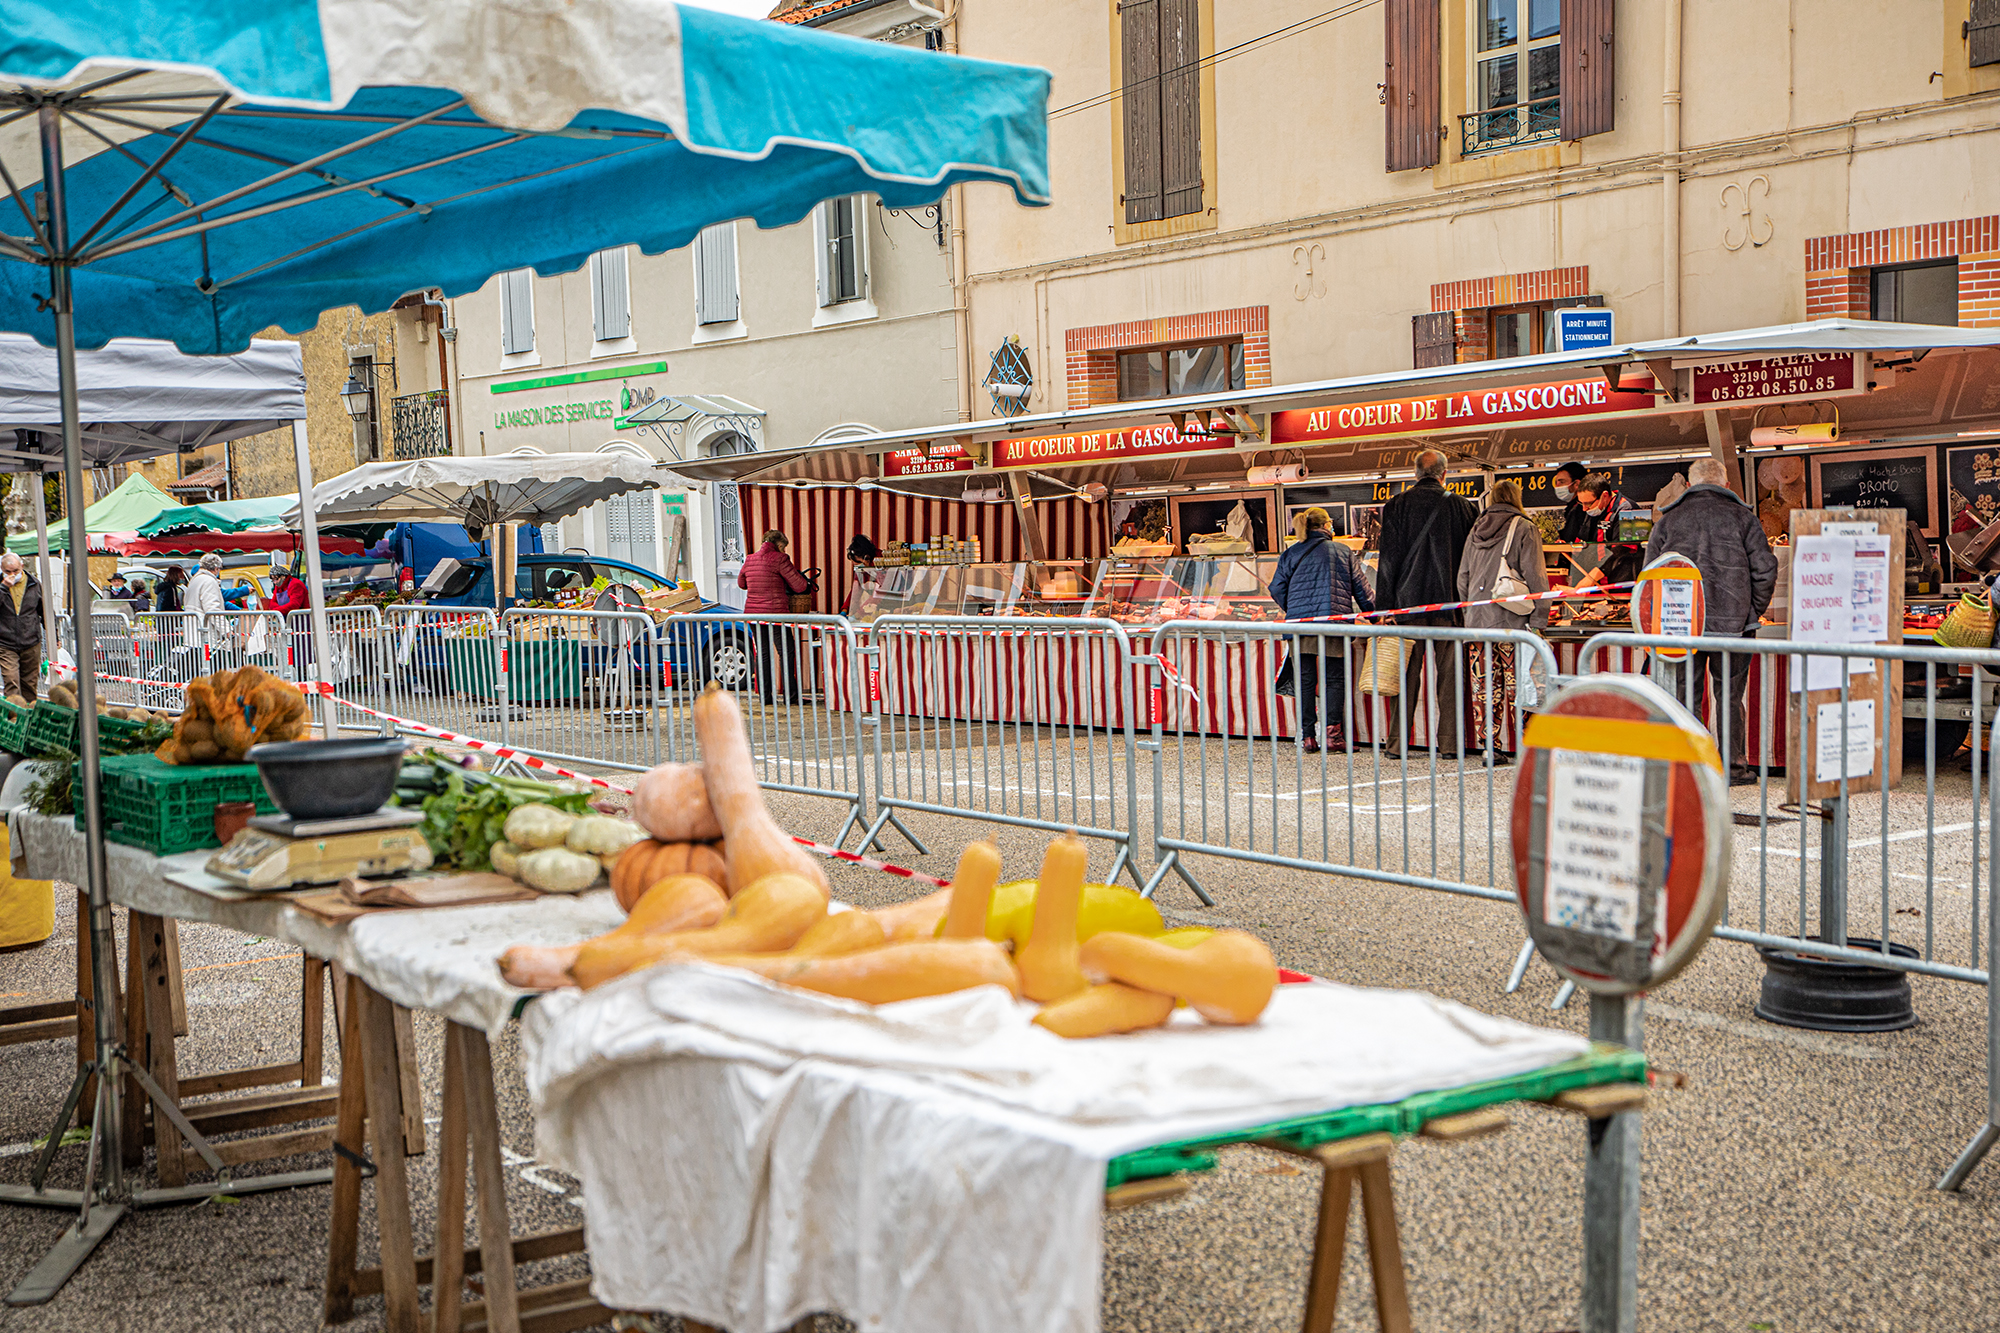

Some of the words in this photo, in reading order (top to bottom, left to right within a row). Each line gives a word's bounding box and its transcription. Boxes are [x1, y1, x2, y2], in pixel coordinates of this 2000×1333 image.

[1566, 319, 1584, 328] ARRÊT
[1586, 319, 1607, 328] MINUTE
[1565, 333, 1609, 341] STATIONNEMENT
[1732, 369, 1768, 384] 32190
[1774, 364, 1813, 380] DEMU
[1711, 376, 1836, 401] 05.62.08.50.85
[1306, 410, 1331, 432] AU
[1338, 403, 1403, 429] COEUR
[1411, 399, 1438, 422] DE
[1445, 395, 1474, 419] LA
[1482, 380, 1607, 415] GASCOGNE
[494, 412, 507, 429] LA
[507, 407, 543, 427] MAISON
[544, 404, 565, 424] DES
[565, 399, 613, 422] SERVICES
[1006, 441, 1025, 459] AU
[1029, 436, 1076, 458] COEUR
[1081, 434, 1101, 453] DE
[1105, 431, 1126, 450] LA
[1131, 421, 1219, 449] GASCOGNE
[901, 461, 955, 475] 05.62.08.50.85
[1528, 475, 1547, 491] se
[1858, 479, 1899, 496] PROMO
[1802, 552, 1818, 563] PORT
[1821, 552, 1831, 562] DU
[1801, 573, 1835, 587] MASQUE
[1800, 597, 1843, 610] OBLIGATOIRE
[1800, 620, 1815, 632] SUR
[1823, 619, 1831, 630] LE
